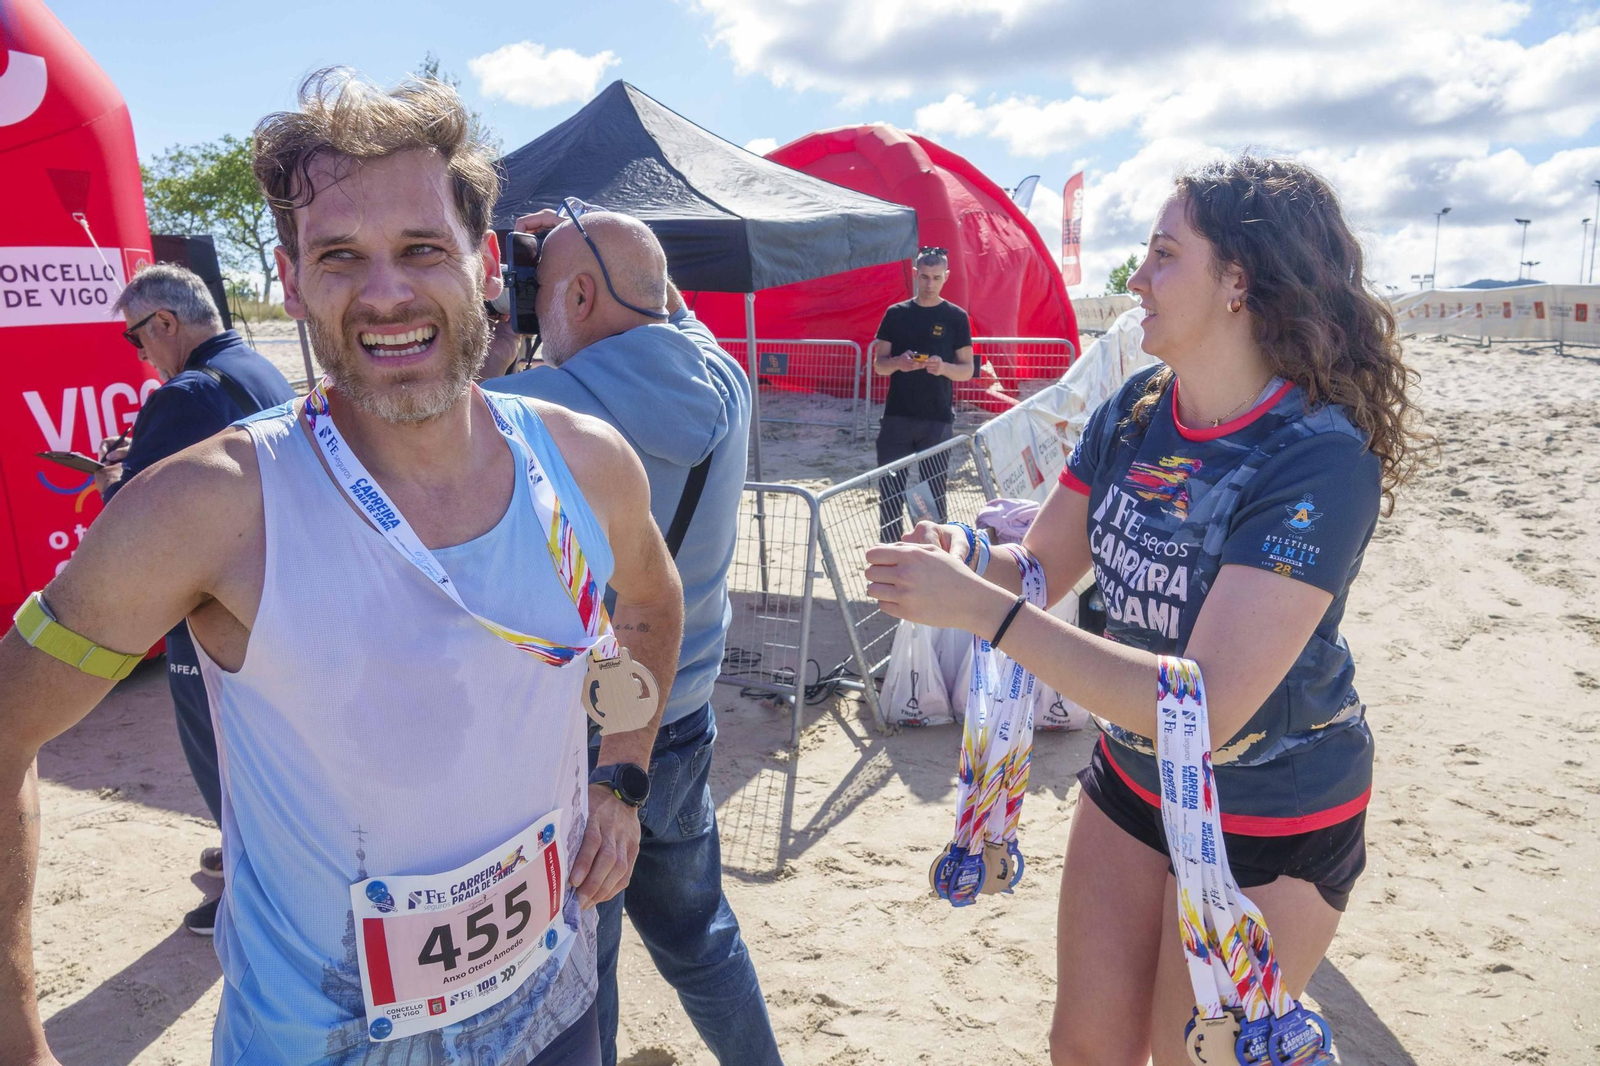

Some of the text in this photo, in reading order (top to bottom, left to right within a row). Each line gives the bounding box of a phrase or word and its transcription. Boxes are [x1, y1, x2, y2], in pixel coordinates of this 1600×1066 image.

[3, 287, 108, 308] DE VIGO
[333, 454, 352, 480] seguros
[349, 484, 369, 506] PRAIA
[366, 503, 377, 514] DE
[355, 478, 401, 529] CARREIRA
[1261, 542, 1316, 565] SAMIL
[1265, 534, 1320, 554] ATLETISMO
[1273, 562, 1292, 573] 28
[1109, 585, 1180, 639] SAMI
[170, 663, 199, 676] RFEA
[1182, 737, 1191, 761] seguros
[1166, 760, 1177, 804] CARREIRA
[1182, 784, 1188, 792] DE
[1188, 765, 1198, 810] CARREIRA
[1209, 846, 1217, 865] PRAIA
[450, 861, 502, 896] CARREIRA
[452, 886, 480, 905] PRAIA
[481, 881, 491, 891] DE
[423, 901, 451, 912] seguros
[417, 880, 533, 972] 455
[442, 972, 467, 984] Anxo
[467, 959, 492, 975] Otero
[493, 938, 524, 962] Amoedo
[476, 975, 497, 993] 100
[386, 1003, 424, 1015] CONCELLO
[402, 1009, 420, 1018] VIGO
[1282, 1027, 1316, 1050] CARREIRA
